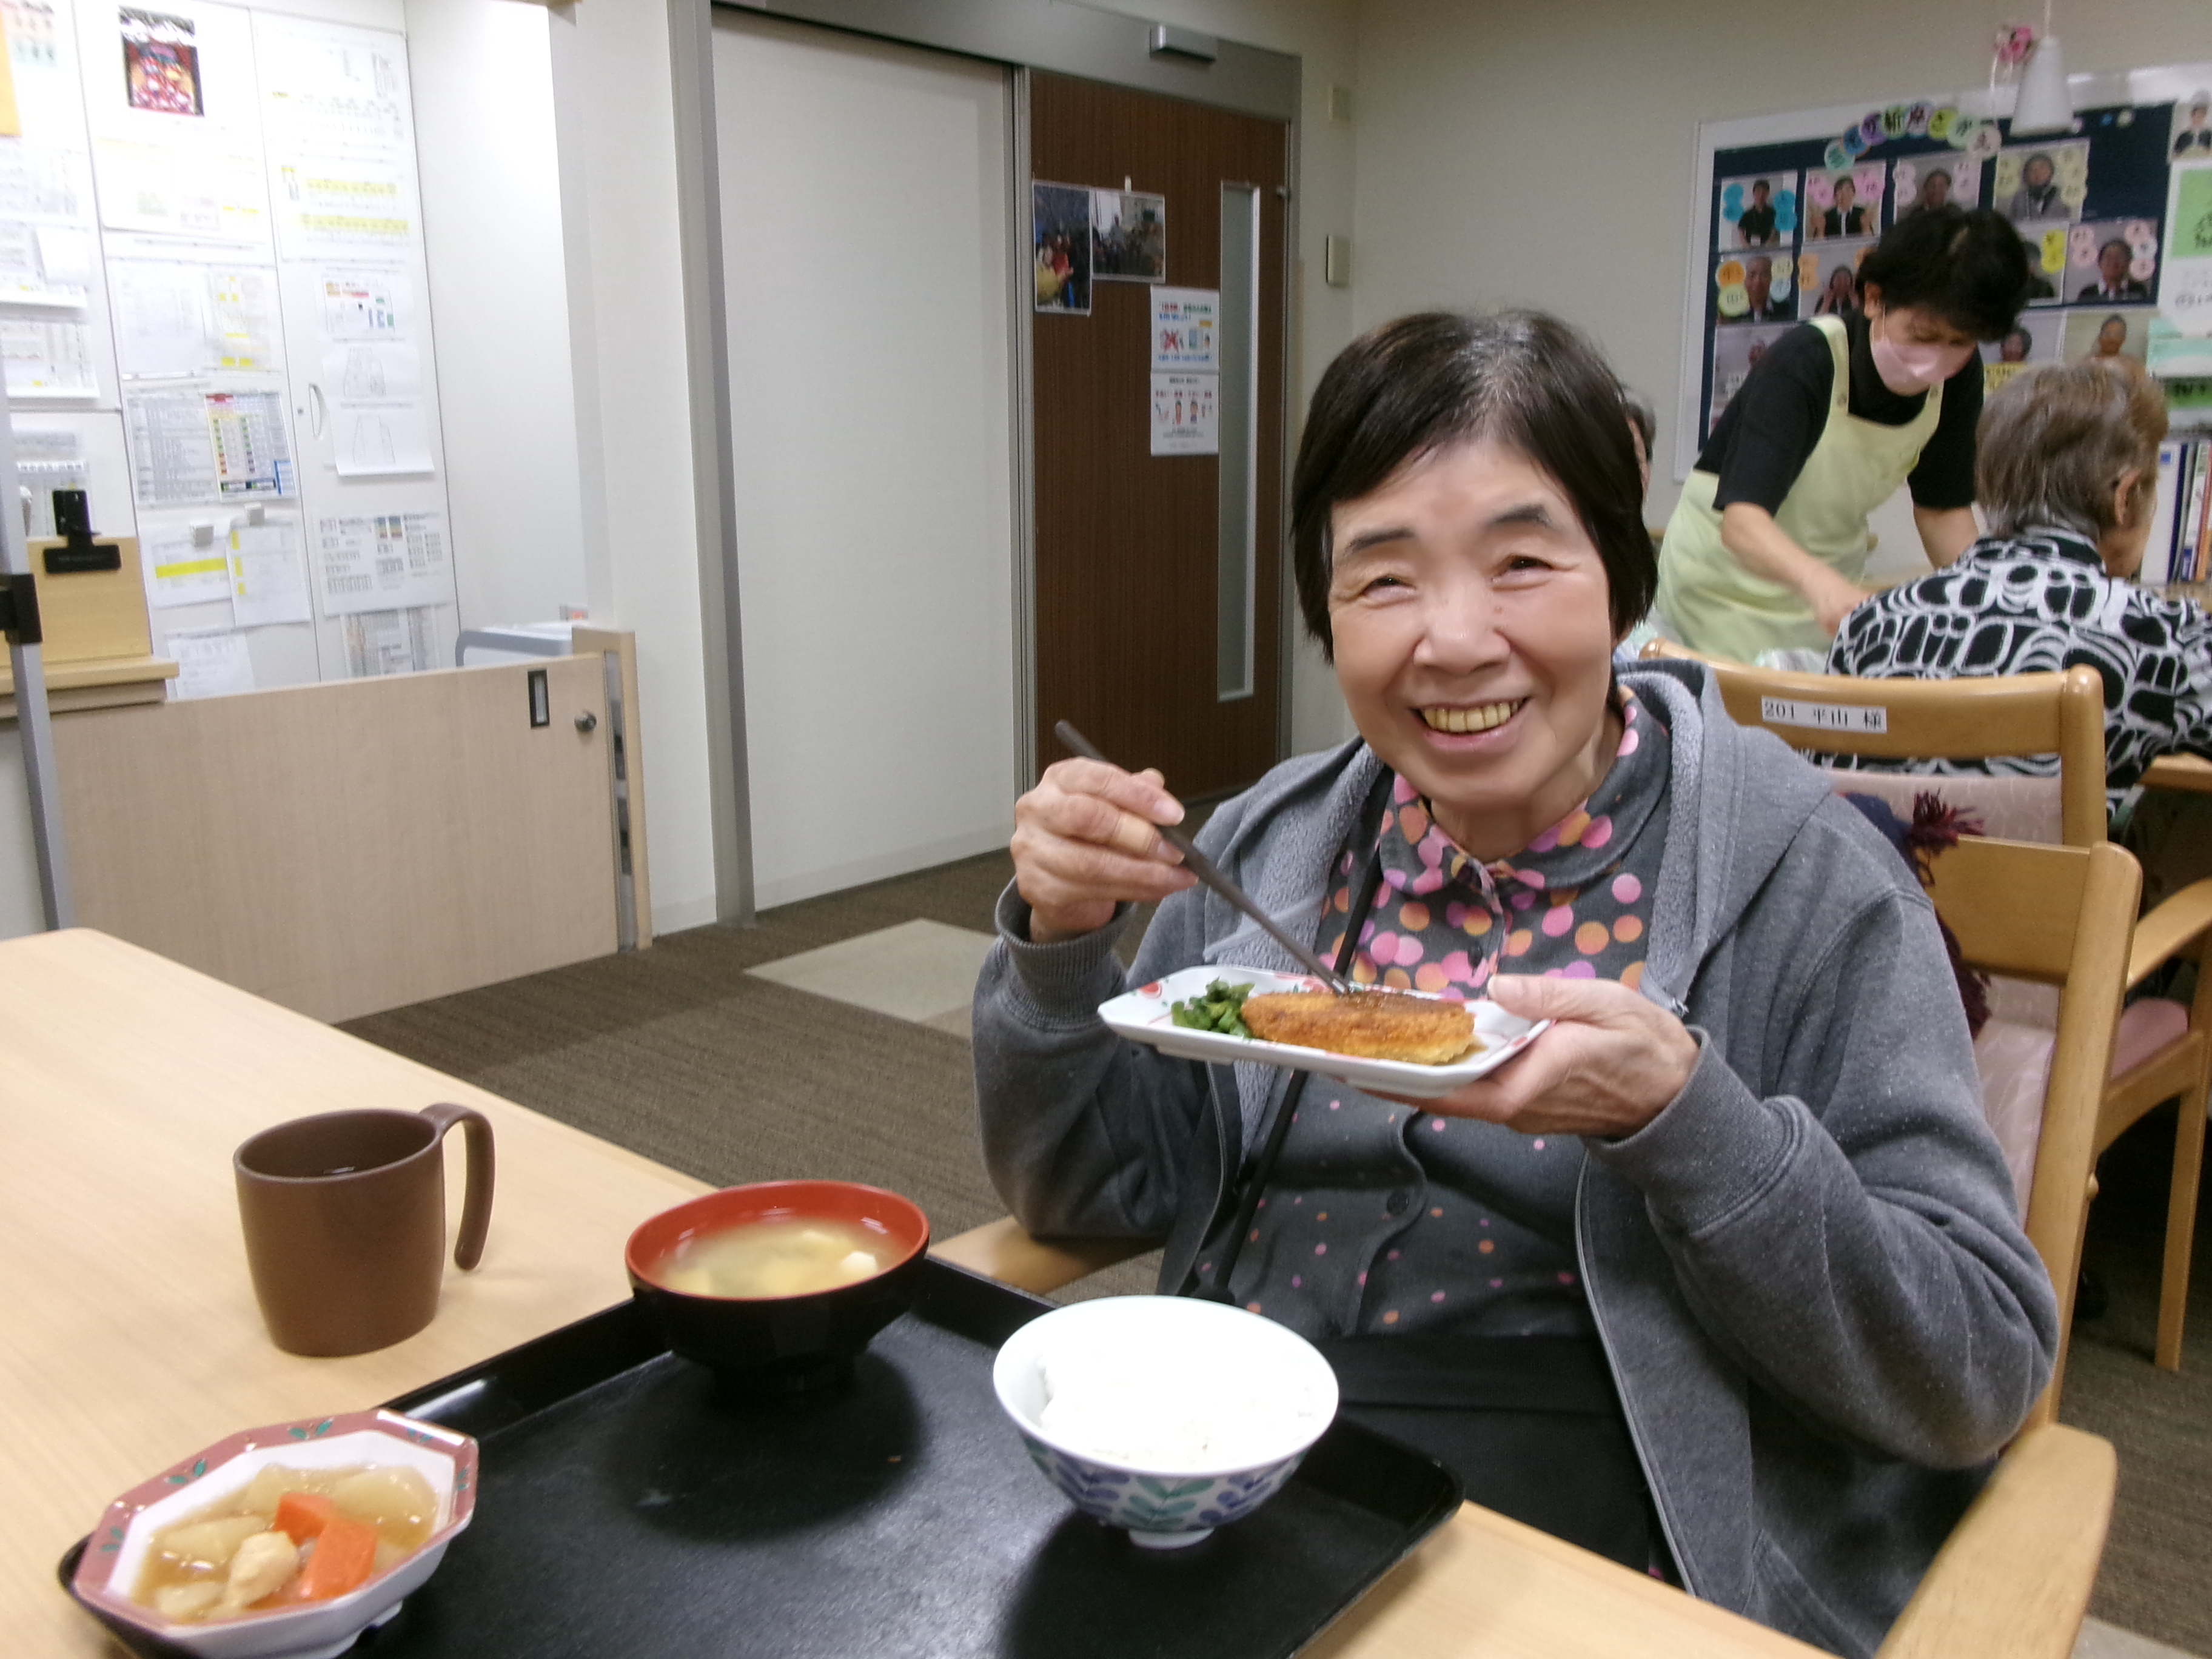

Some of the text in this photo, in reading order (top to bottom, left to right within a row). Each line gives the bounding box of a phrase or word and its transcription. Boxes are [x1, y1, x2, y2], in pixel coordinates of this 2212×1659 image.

[1765, 701, 1882, 729] 201 平山 様
